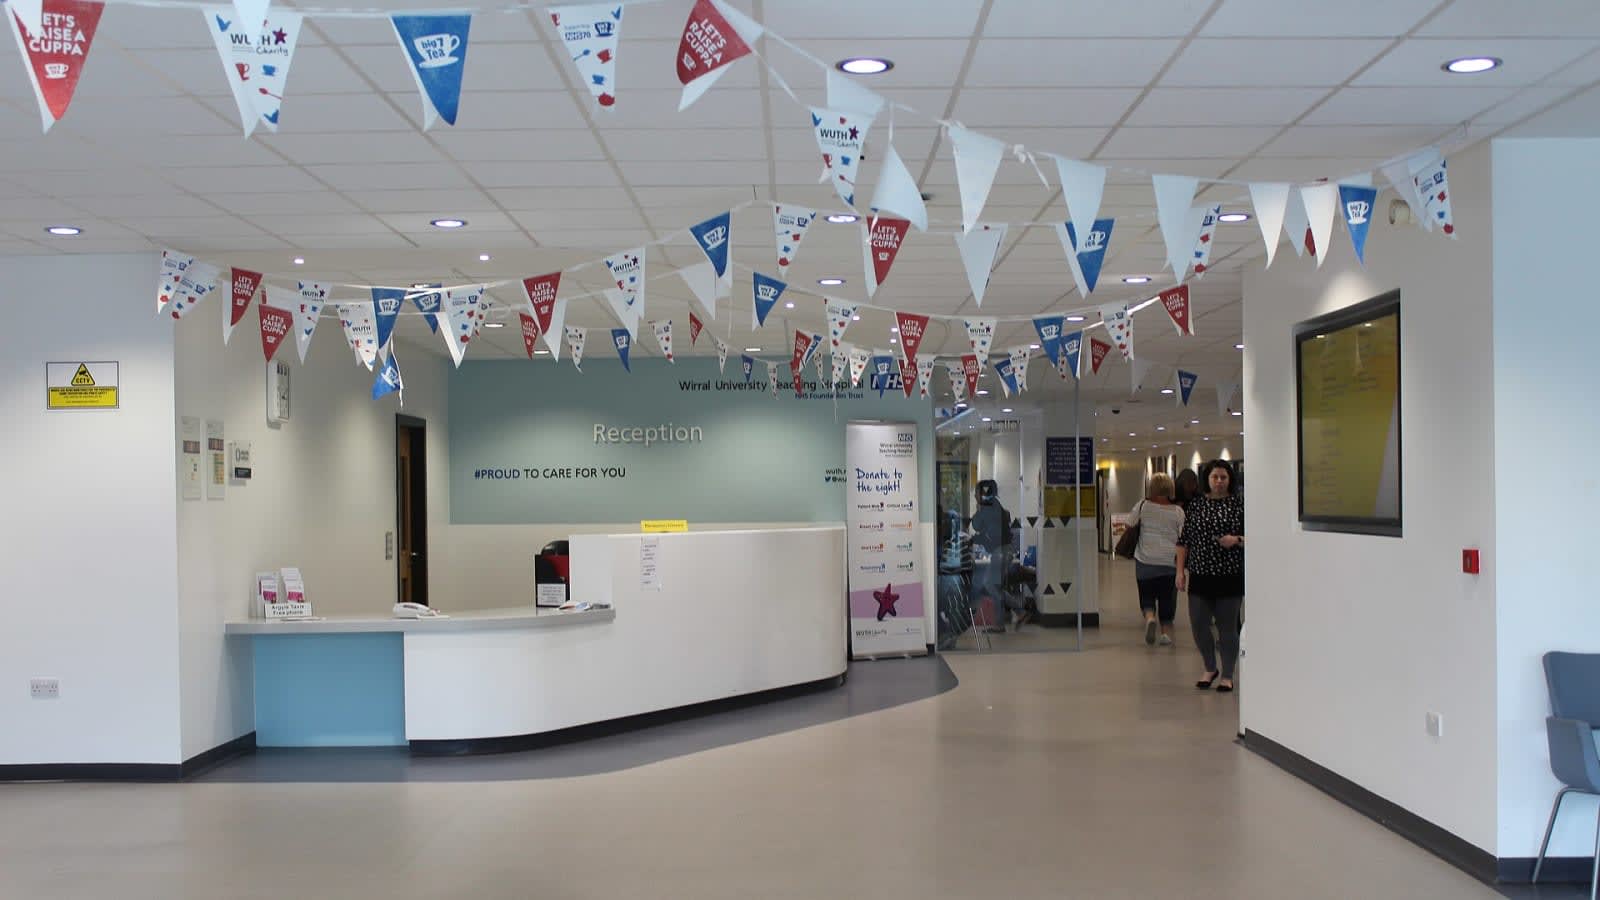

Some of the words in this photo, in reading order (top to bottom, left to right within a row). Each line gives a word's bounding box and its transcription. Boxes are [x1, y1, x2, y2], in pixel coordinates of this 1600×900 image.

[42, 13, 76, 28] ET'S
[688, 21, 718, 55] RAISE
[700, 18, 727, 49] LET'S
[28, 39, 84, 56] CUPPA
[256, 46, 289, 57] Charity
[685, 31, 713, 69] CUPPA
[820, 128, 848, 140] WUTH
[877, 226, 897, 234] LET'S
[873, 232, 895, 241] RAISE
[873, 240, 898, 249] CUPPA
[534, 281, 552, 291] LET'S
[533, 294, 555, 304] CUPPA
[679, 380, 711, 391] Wirral
[715, 380, 767, 393] University
[592, 423, 704, 447] Reception
[898, 433, 913, 441] NHS
[474, 468, 520, 479] #PROUD
[524, 468, 539, 478] TO
[543, 467, 572, 479] CARE
[575, 467, 598, 478] FOR
[601, 467, 626, 478] YOU
[855, 467, 890, 480] Donate
[894, 468, 903, 480] to
[857, 481, 873, 493] the
[875, 480, 901, 496] eight!
